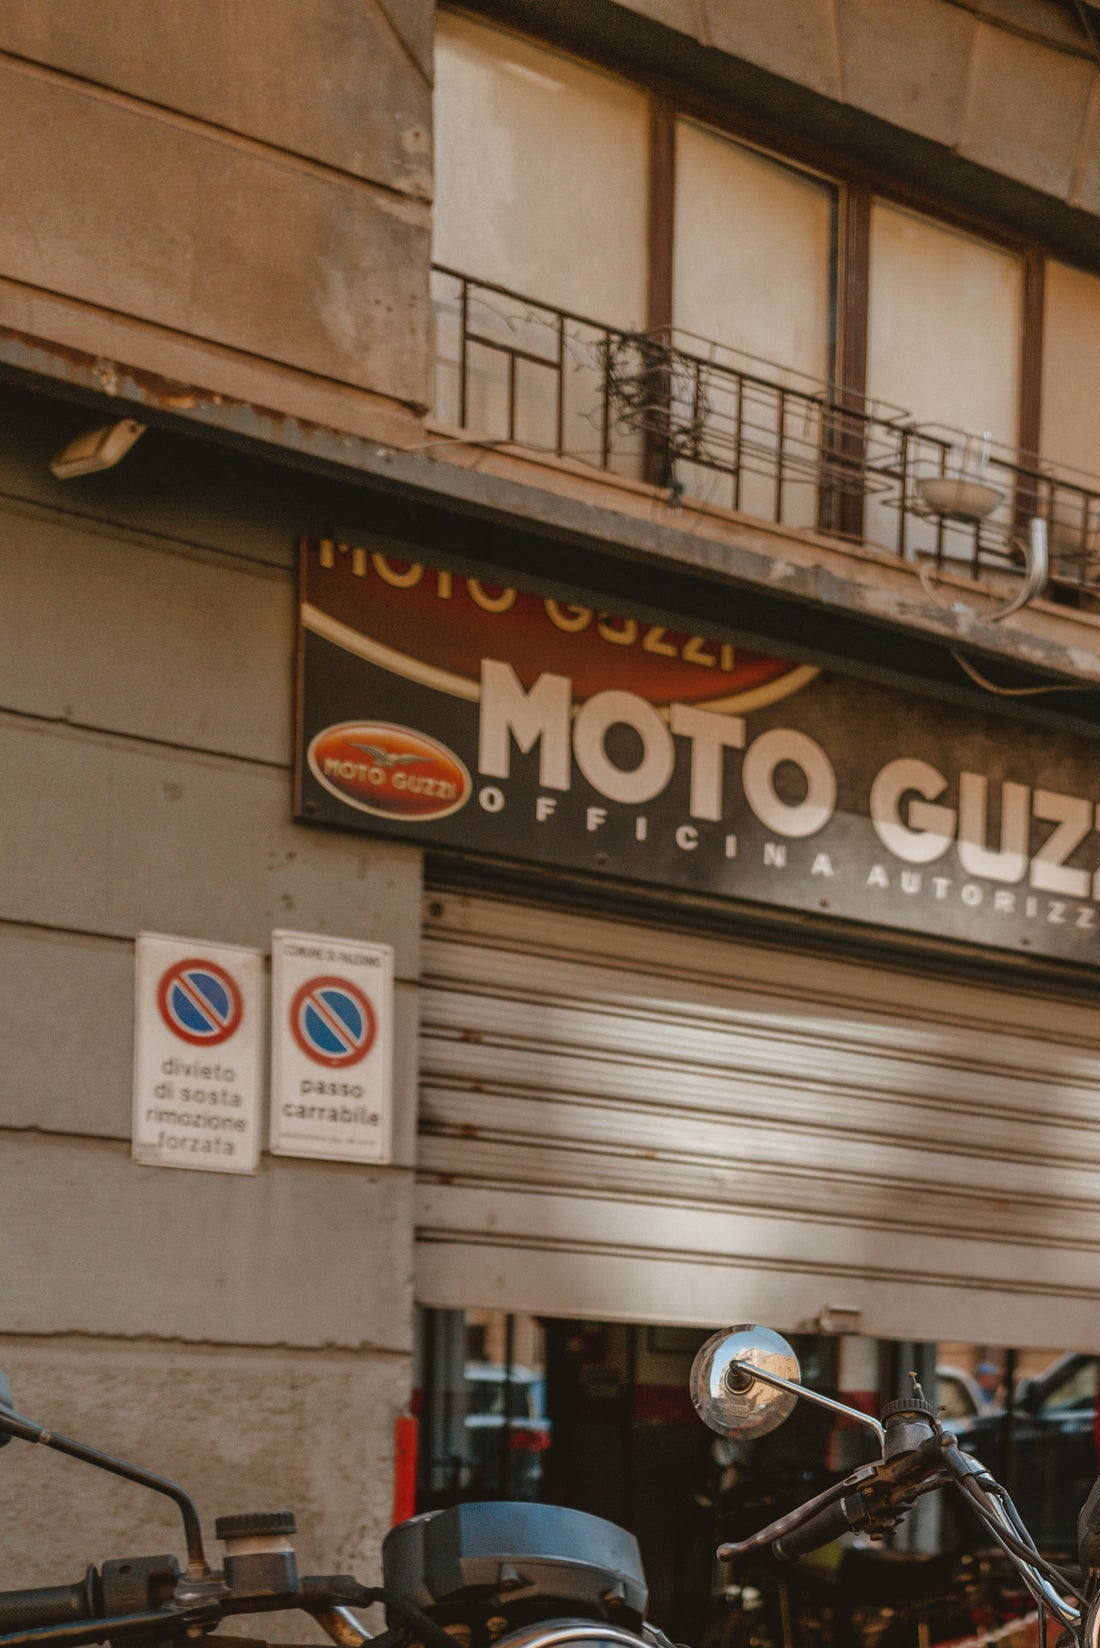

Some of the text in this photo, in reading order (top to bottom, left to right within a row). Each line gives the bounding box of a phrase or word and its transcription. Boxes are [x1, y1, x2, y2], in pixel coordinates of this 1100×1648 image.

[478, 657, 837, 837] MOTO
[323, 758, 457, 799] MOTO GUZZI
[478, 786, 836, 878] OFFICINA
[161, 1057, 236, 1083] divieto
[154, 1081, 242, 1108] di sosta
[302, 1080, 363, 1099] passo
[145, 1106, 247, 1133] rimozione
[282, 1104, 379, 1127] carrabile
[158, 1131, 236, 1156] forzata
